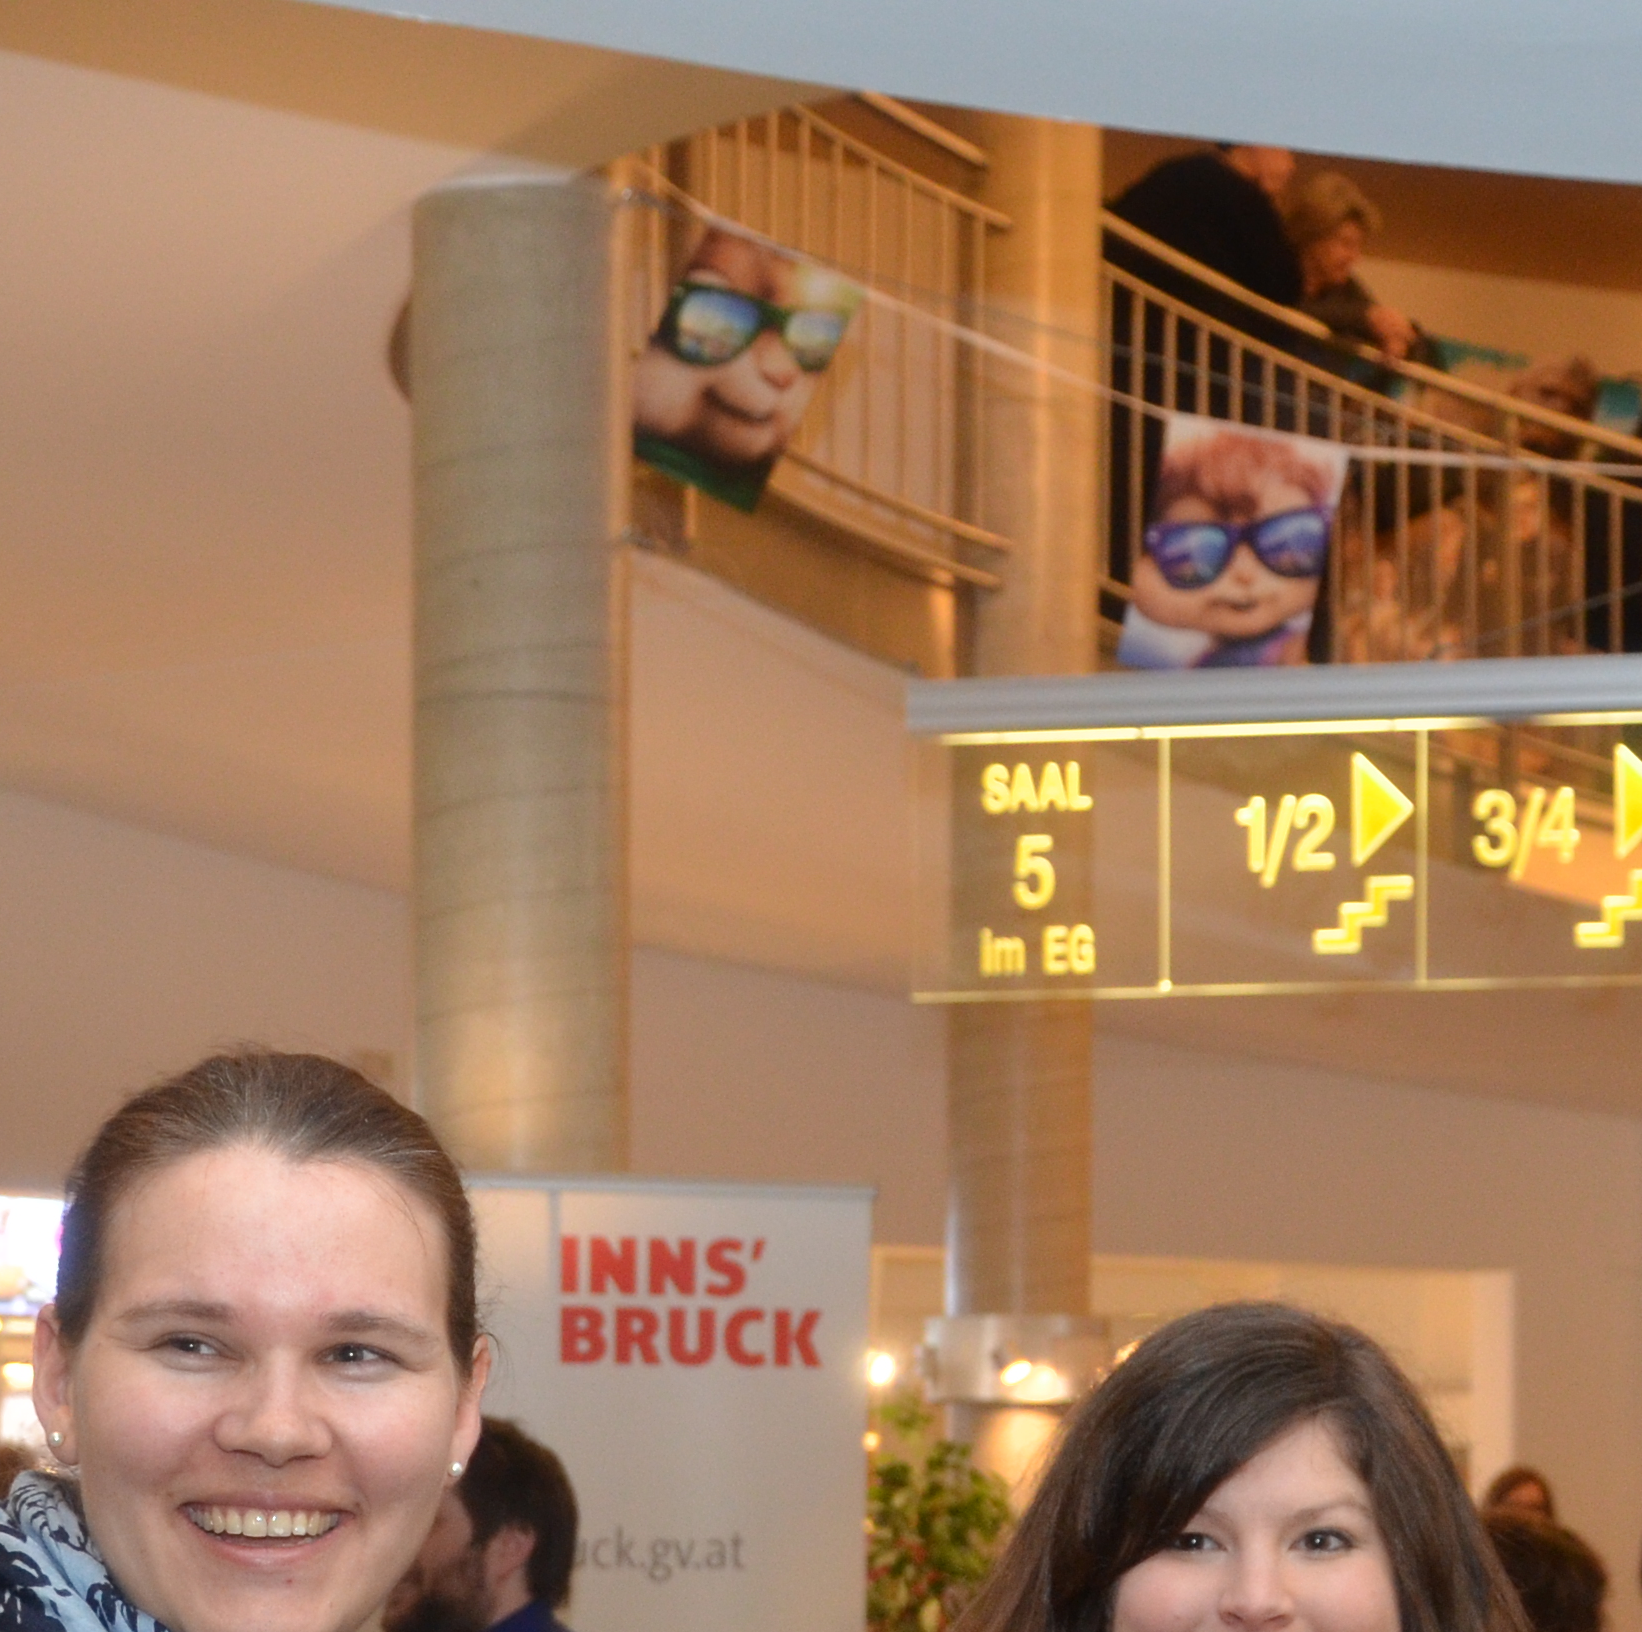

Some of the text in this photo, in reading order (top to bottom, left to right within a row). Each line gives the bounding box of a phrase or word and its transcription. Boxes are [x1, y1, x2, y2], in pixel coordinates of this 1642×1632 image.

[981, 761, 1093, 814] SAAL
[1235, 792, 1335, 887] 1/2
[1473, 786, 1580, 881] 3/4
[1012, 833, 1057, 910] 5
[1042, 913, 1096, 966] EG
[559, 1235, 766, 1297] INNS'
[560, 1305, 821, 1368] BRUCK
